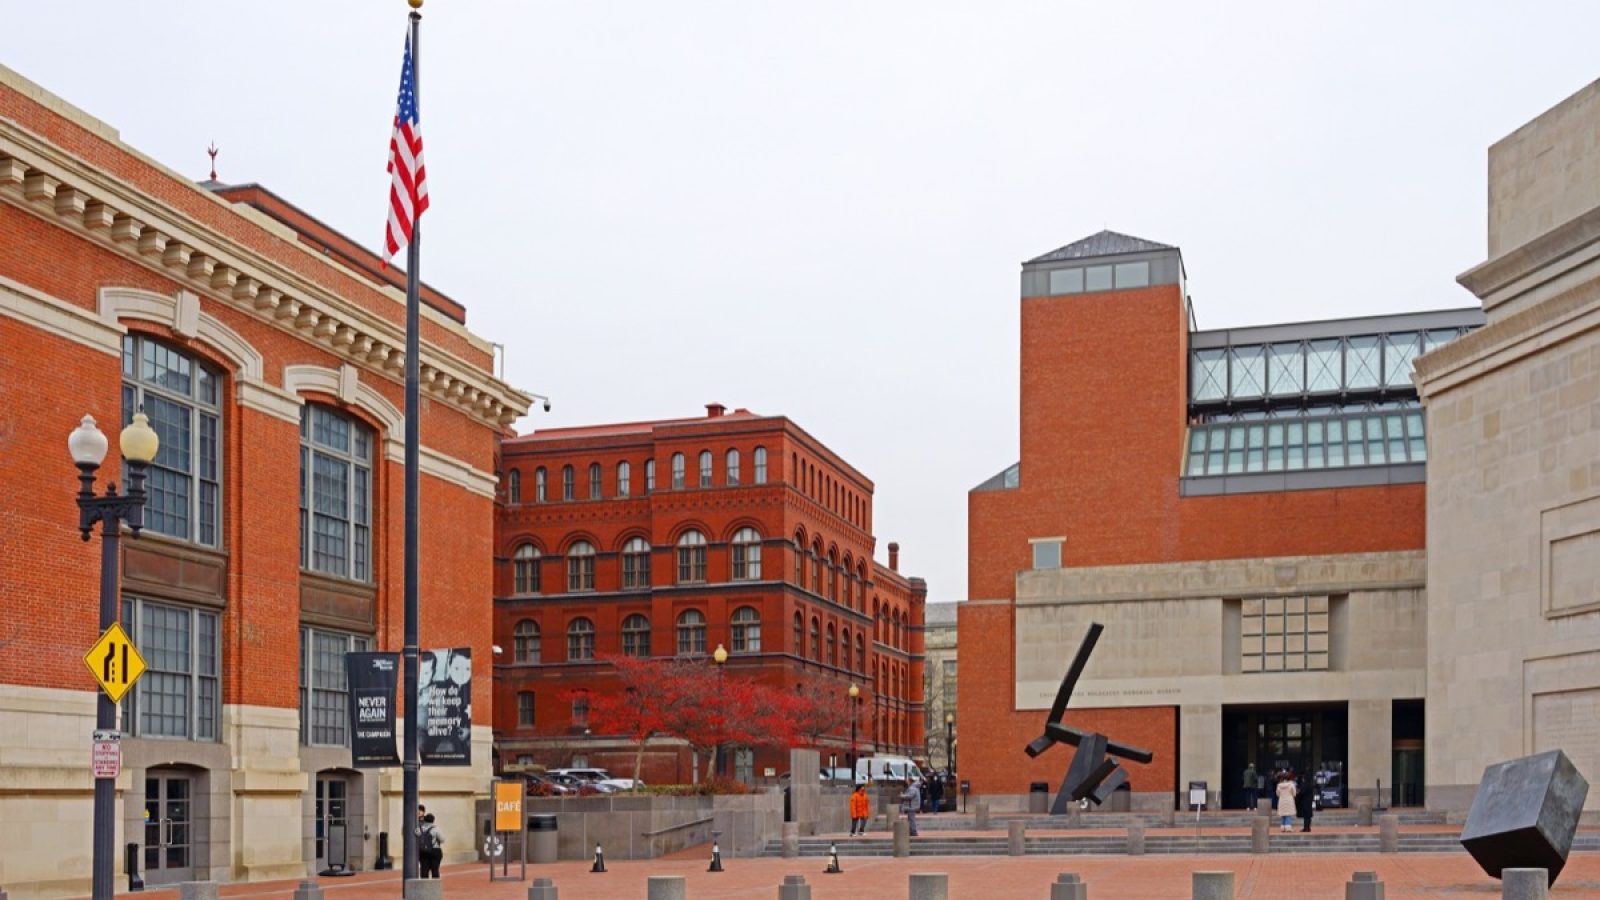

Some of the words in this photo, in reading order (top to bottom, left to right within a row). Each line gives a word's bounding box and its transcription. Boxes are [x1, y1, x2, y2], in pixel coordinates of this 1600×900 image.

[428, 685, 447, 697] How
[448, 685, 459, 696] do
[358, 696, 386, 707] NEVER
[442, 696, 462, 707] keep
[359, 708, 386, 718] AGAIN
[428, 706, 448, 716] their
[428, 717, 462, 728] memory
[428, 726, 453, 737] alive?
[497, 800, 521, 811] CAFÉ
